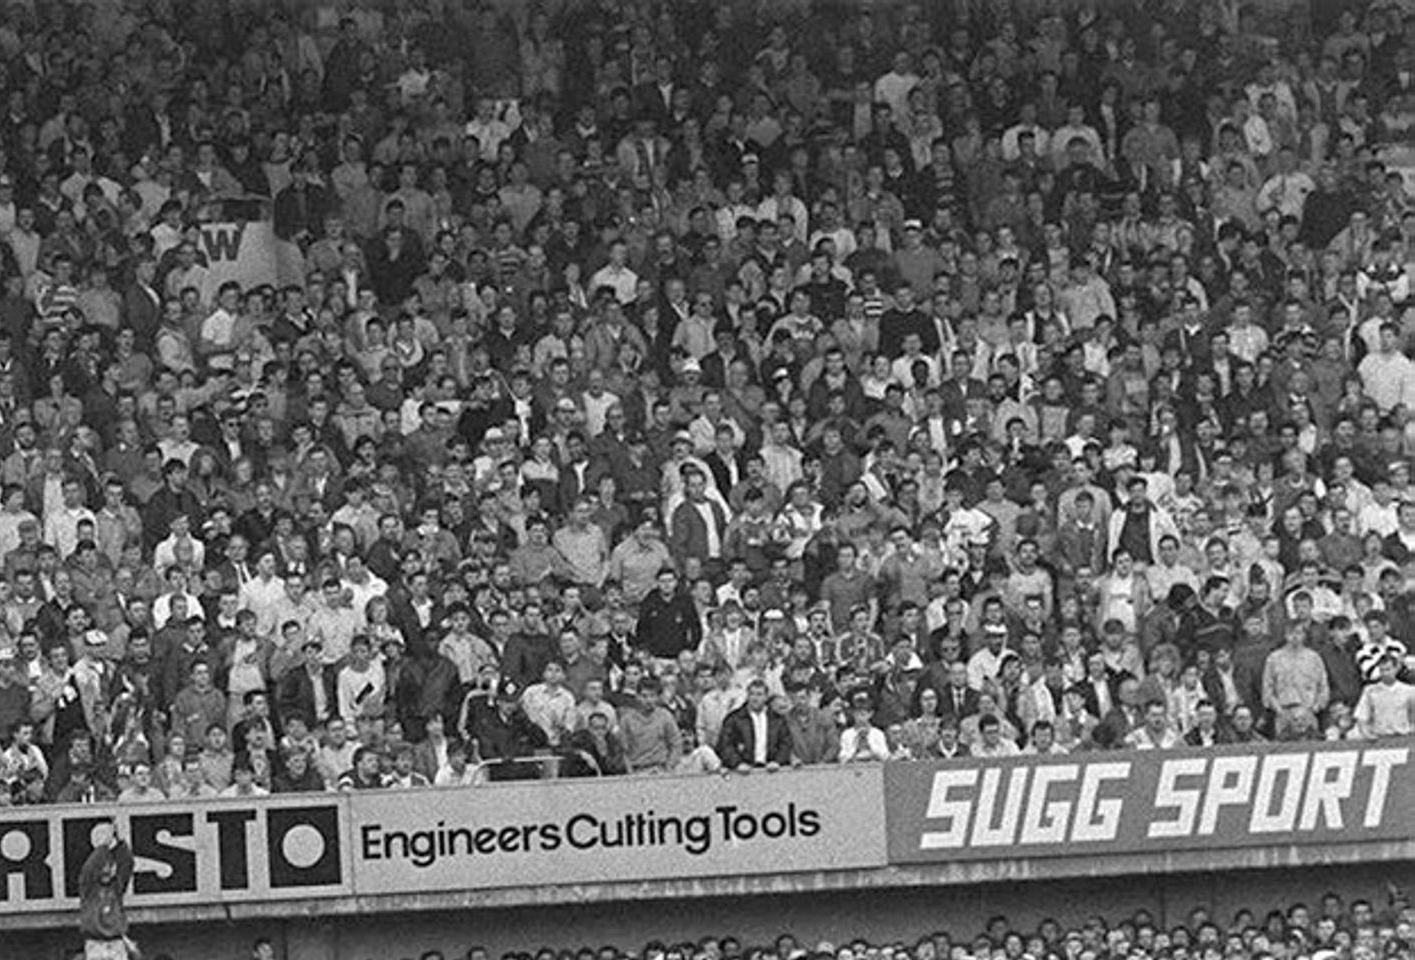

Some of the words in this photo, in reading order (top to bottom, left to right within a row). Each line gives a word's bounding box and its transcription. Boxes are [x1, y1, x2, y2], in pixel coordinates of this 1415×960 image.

[202, 229, 242, 261] W
[919, 762, 1132, 849] SUGG
[1147, 747, 1410, 838] SPORT
[360, 821, 561, 867] Engineers
[566, 810, 711, 855] Cutting
[715, 803, 821, 842] Tools
